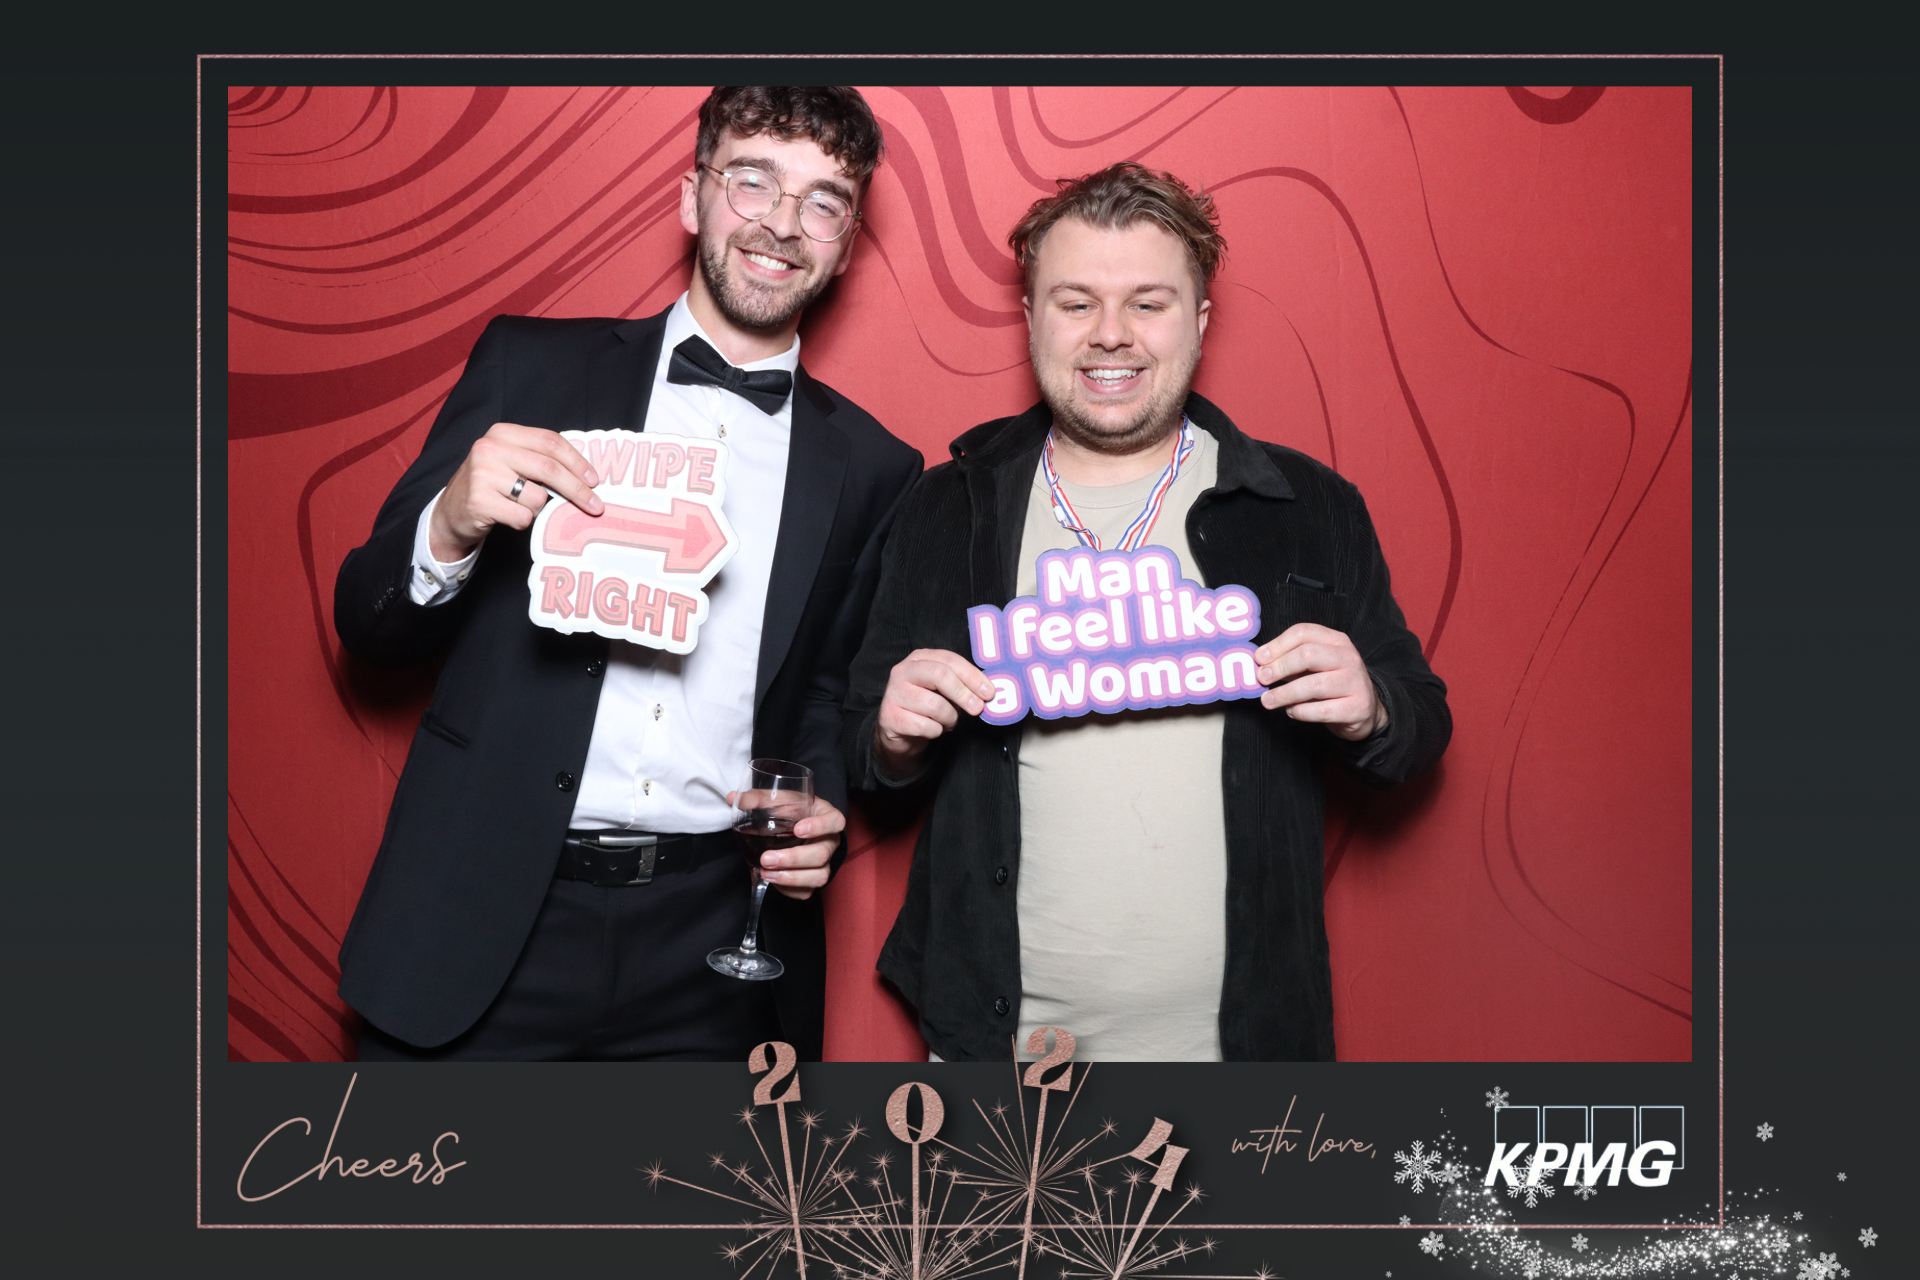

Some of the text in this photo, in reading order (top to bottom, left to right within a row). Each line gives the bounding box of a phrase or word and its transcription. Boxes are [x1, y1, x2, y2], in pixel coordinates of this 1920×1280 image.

[540, 565, 698, 643] RIGHT
[1047, 556, 1171, 603] Man
[979, 589, 1250, 658] I feel like
[984, 652, 1257, 714] a Woman
